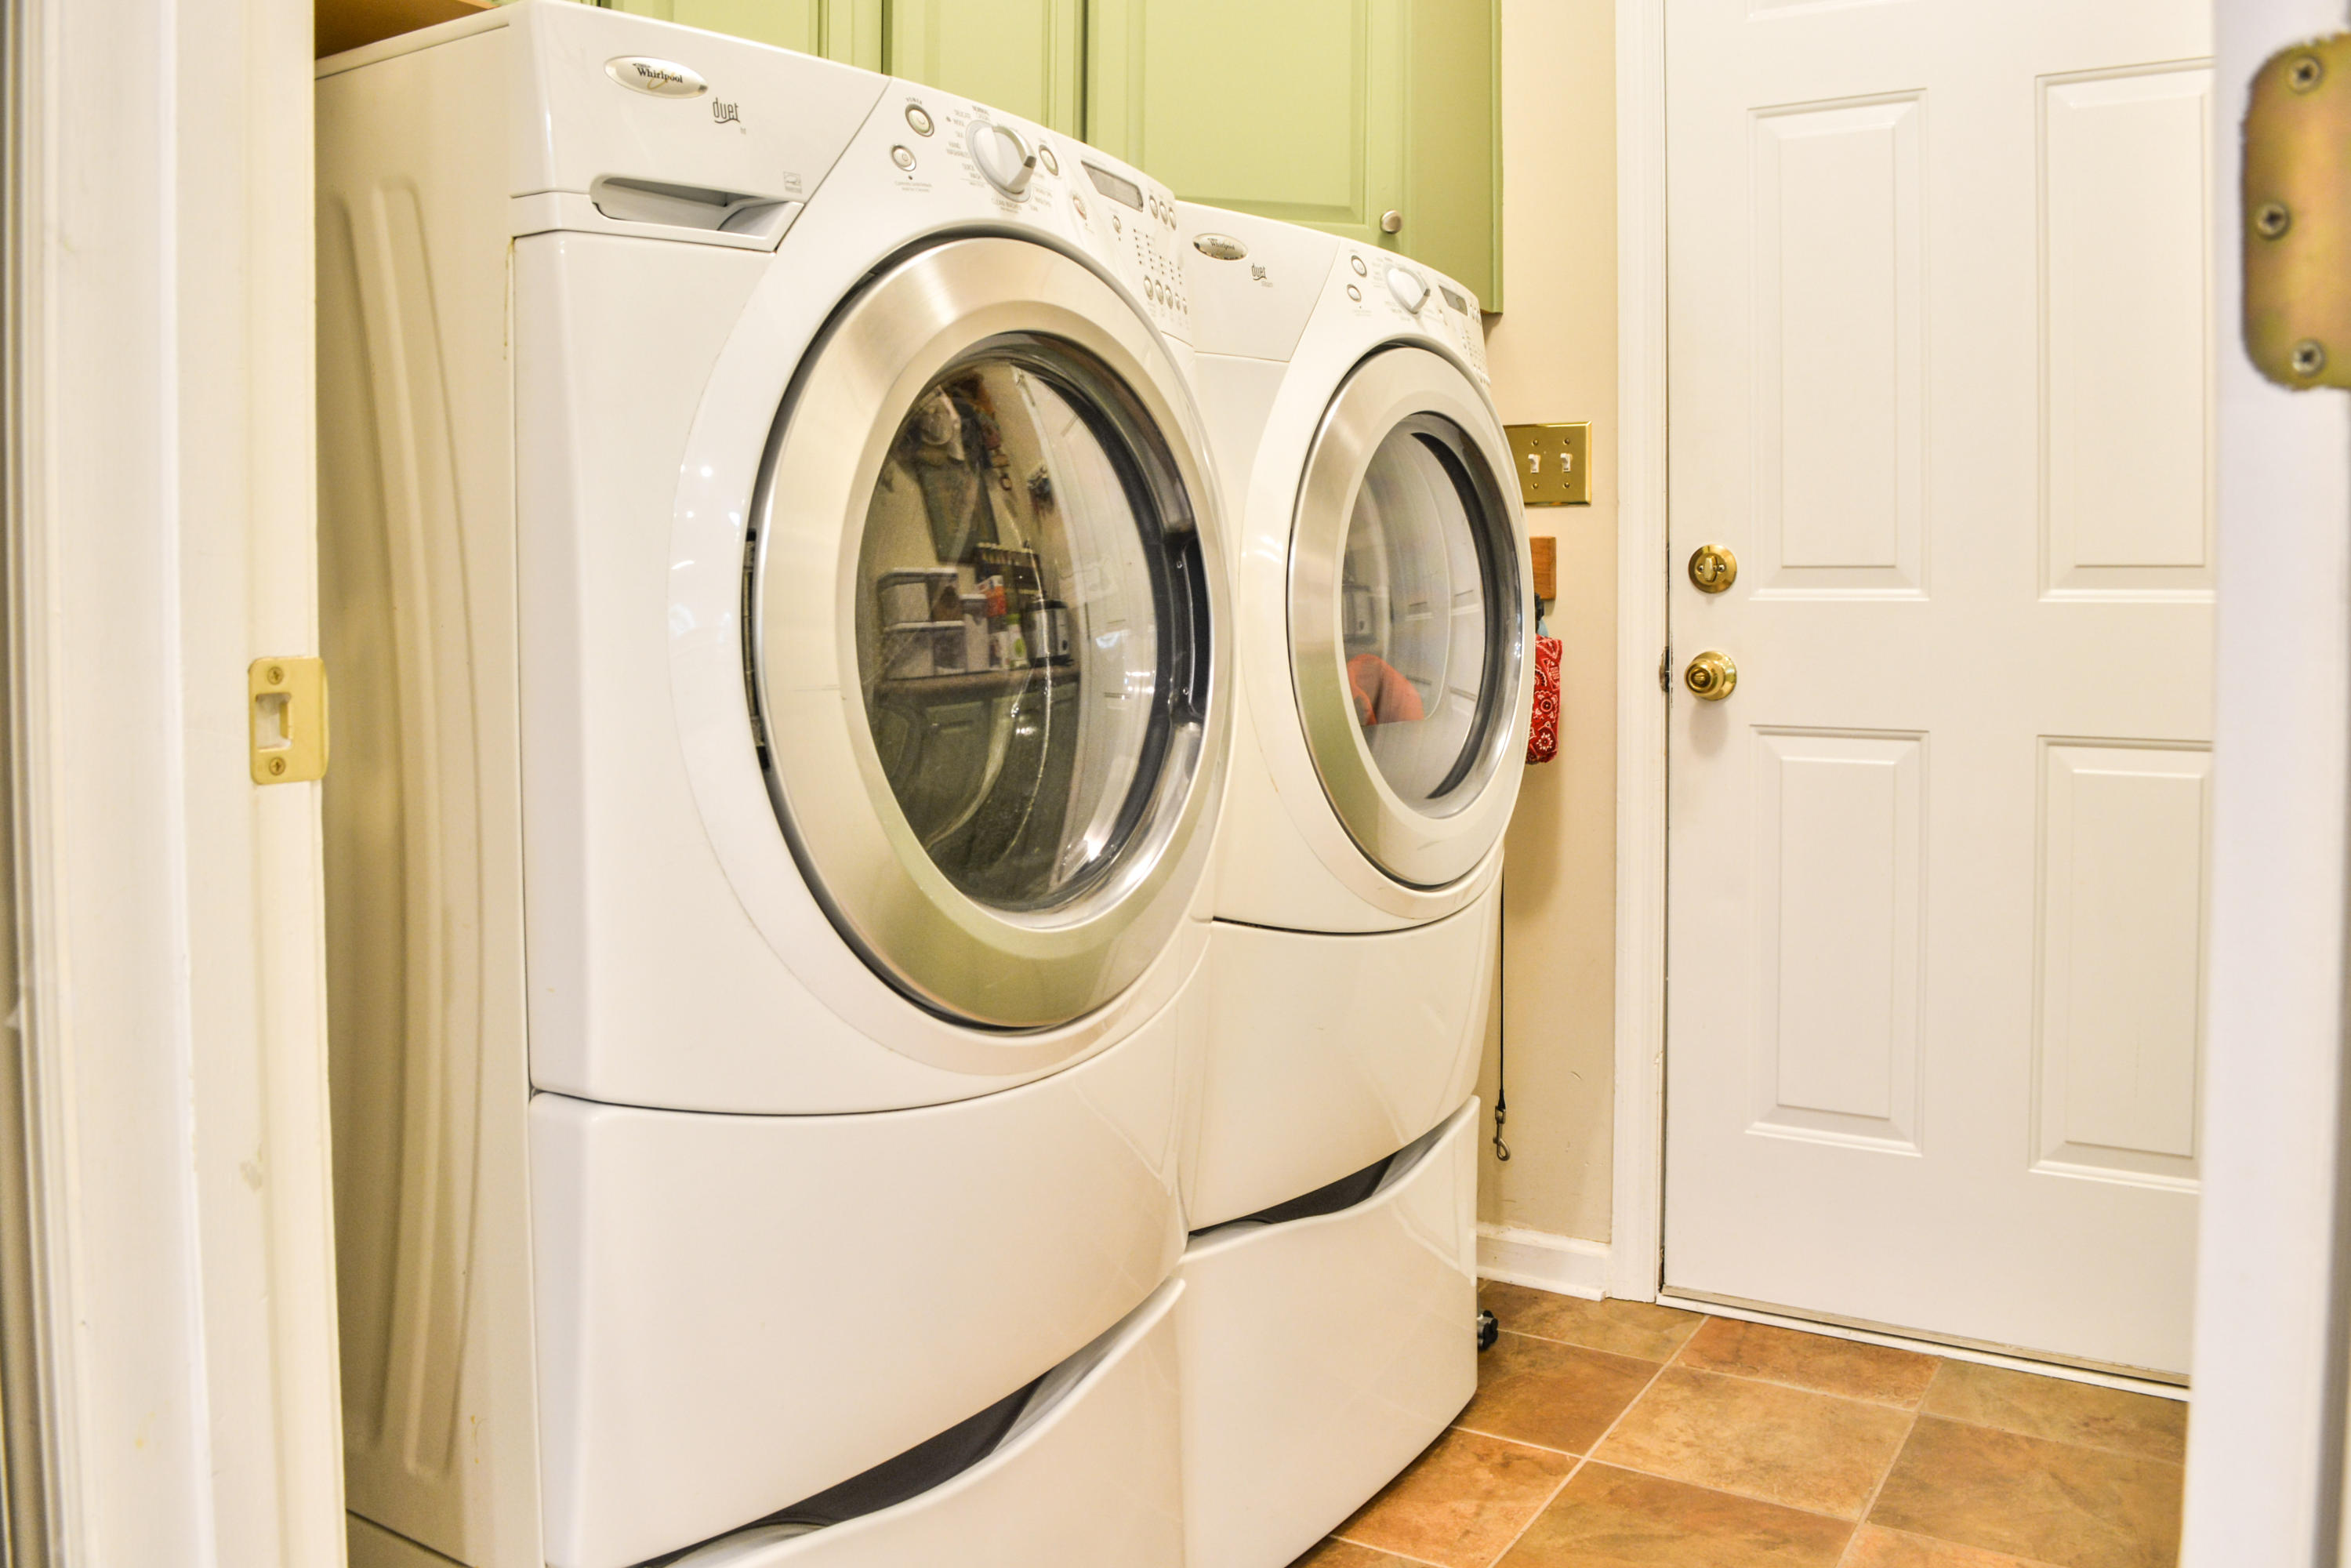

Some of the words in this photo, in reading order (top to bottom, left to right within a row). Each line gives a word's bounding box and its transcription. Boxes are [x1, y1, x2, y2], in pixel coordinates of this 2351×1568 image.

[637, 67, 684, 84] Whirlpool
[712, 96, 740, 122] duet
[1251, 263, 1267, 278] duet
